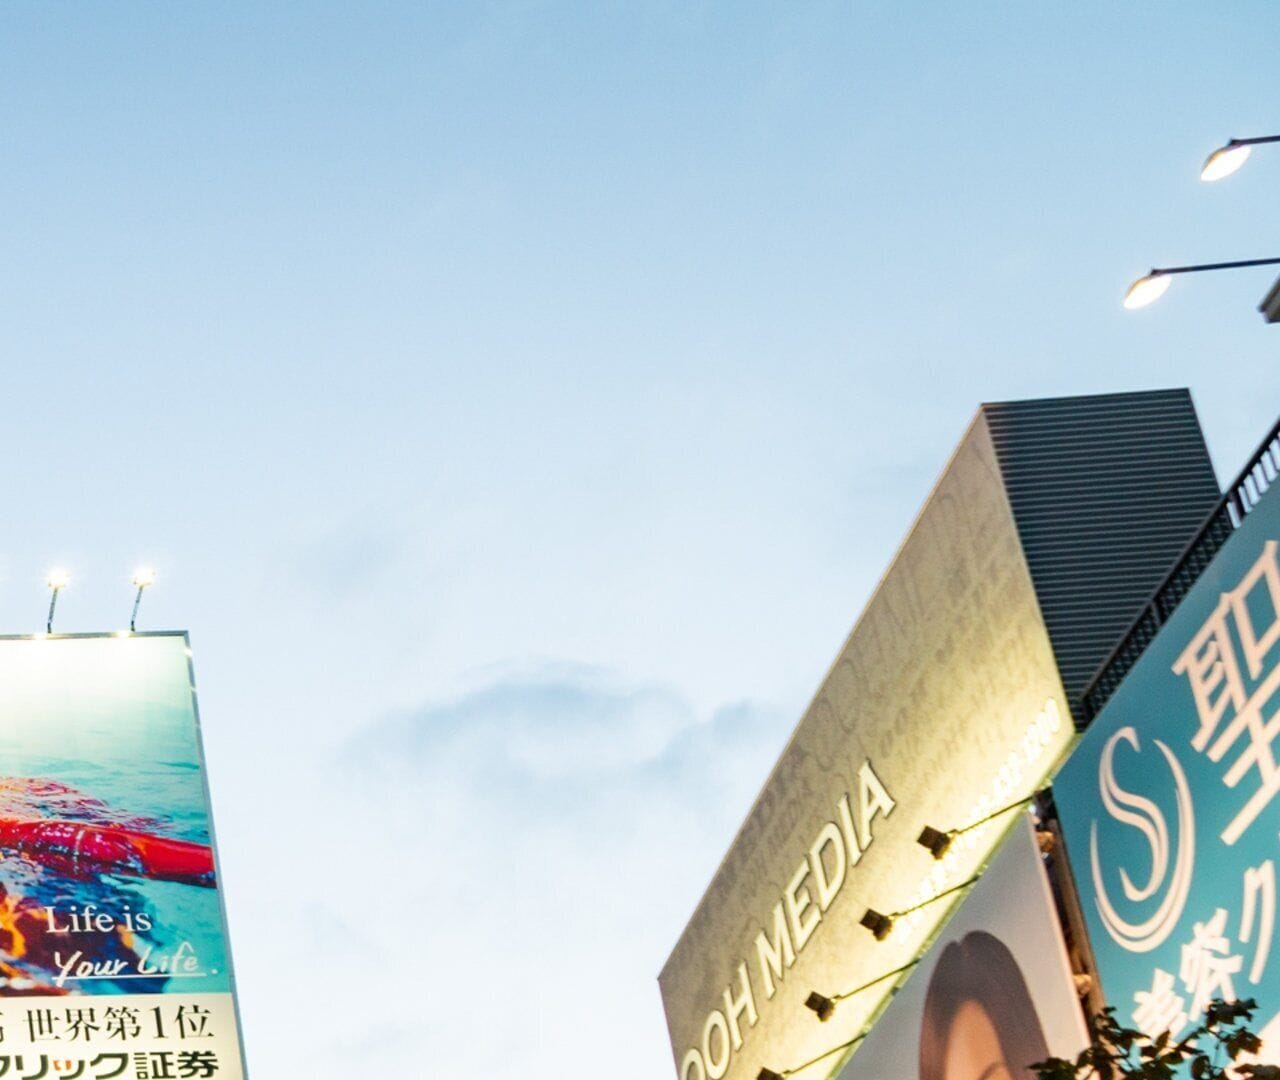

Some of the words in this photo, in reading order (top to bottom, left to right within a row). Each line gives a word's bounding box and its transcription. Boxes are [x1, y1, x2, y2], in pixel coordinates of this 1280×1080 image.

[755, 760, 896, 1000] MEDIA
[44, 905, 115, 934] Life
[124, 905, 153, 933] is
[54, 950, 128, 988] Your
[21, 1004, 215, 1043] 世界第1位
